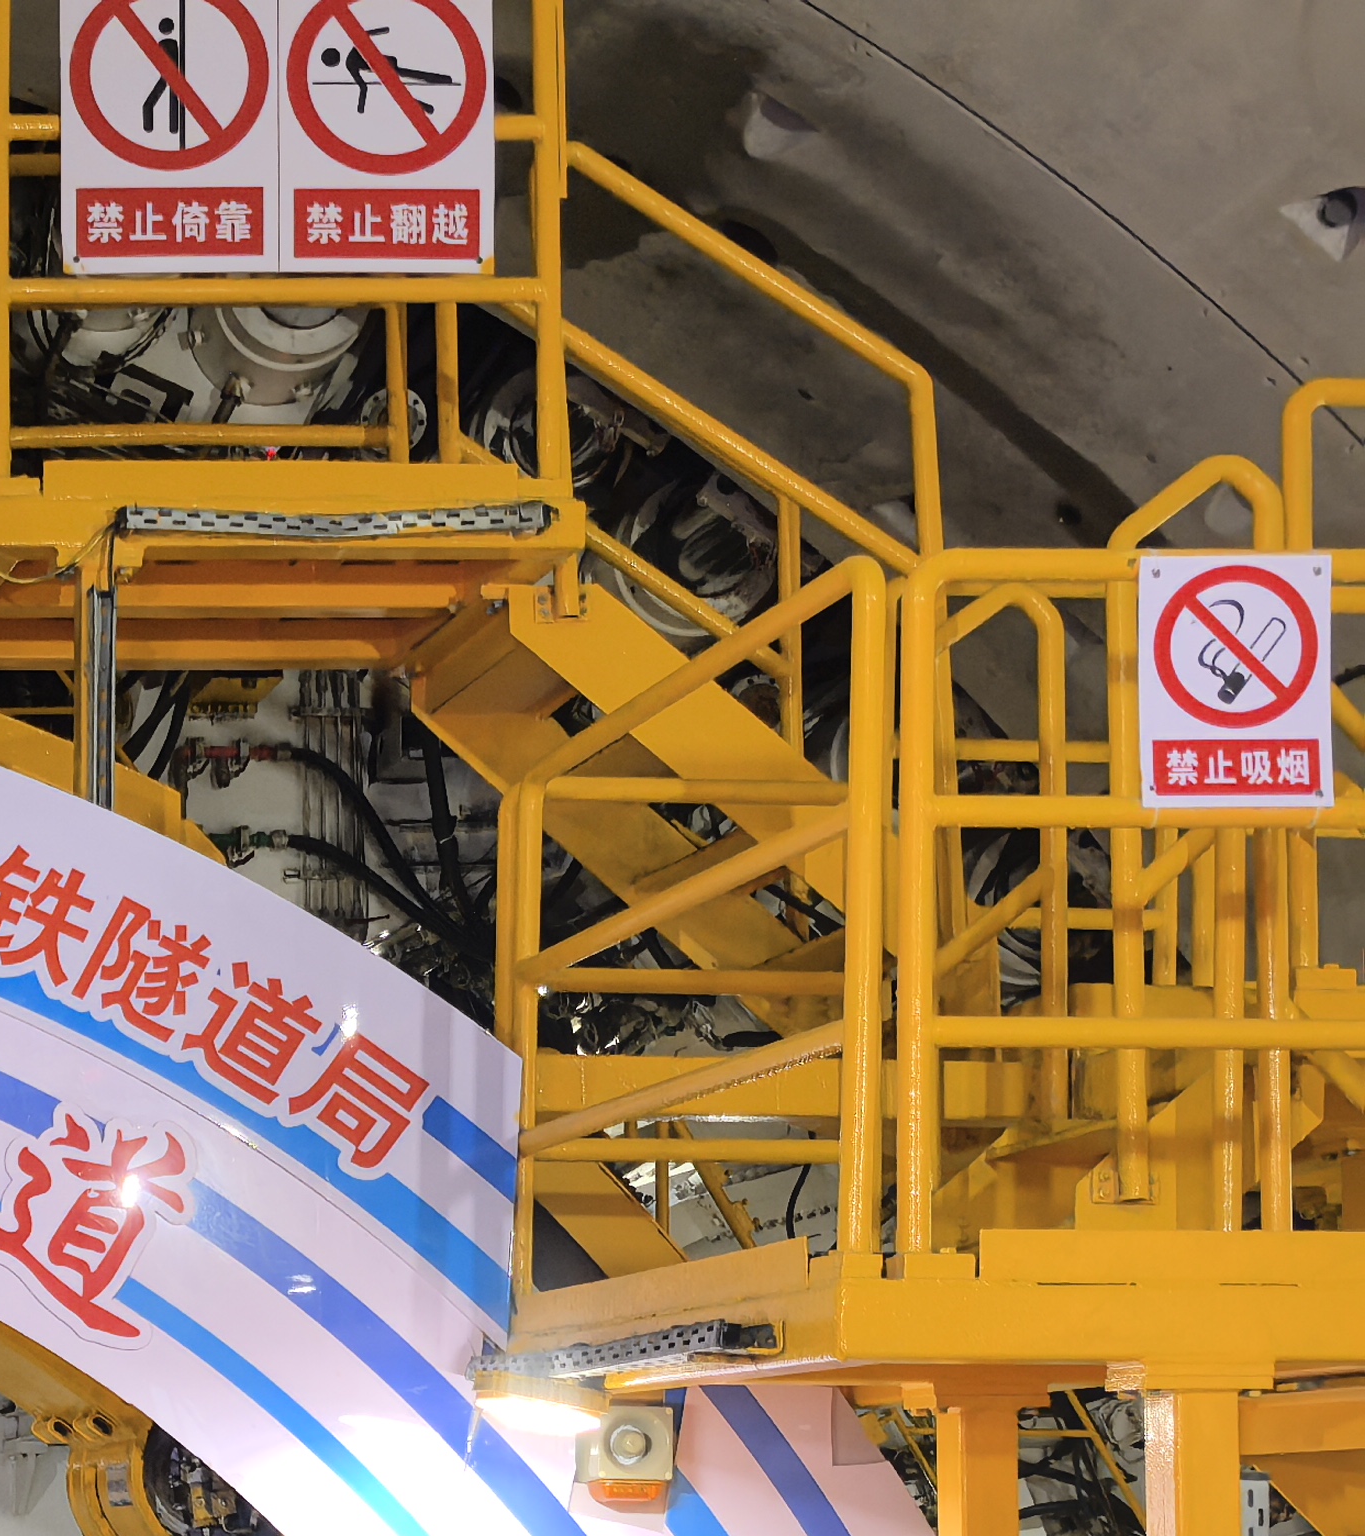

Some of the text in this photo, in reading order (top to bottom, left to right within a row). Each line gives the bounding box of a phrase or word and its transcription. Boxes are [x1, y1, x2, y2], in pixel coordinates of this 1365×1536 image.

[86, 201, 253, 244] 禁止倚靠
[306, 203, 470, 246] 禁止翻越
[1166, 749, 1310, 786] 禁止吸烟
